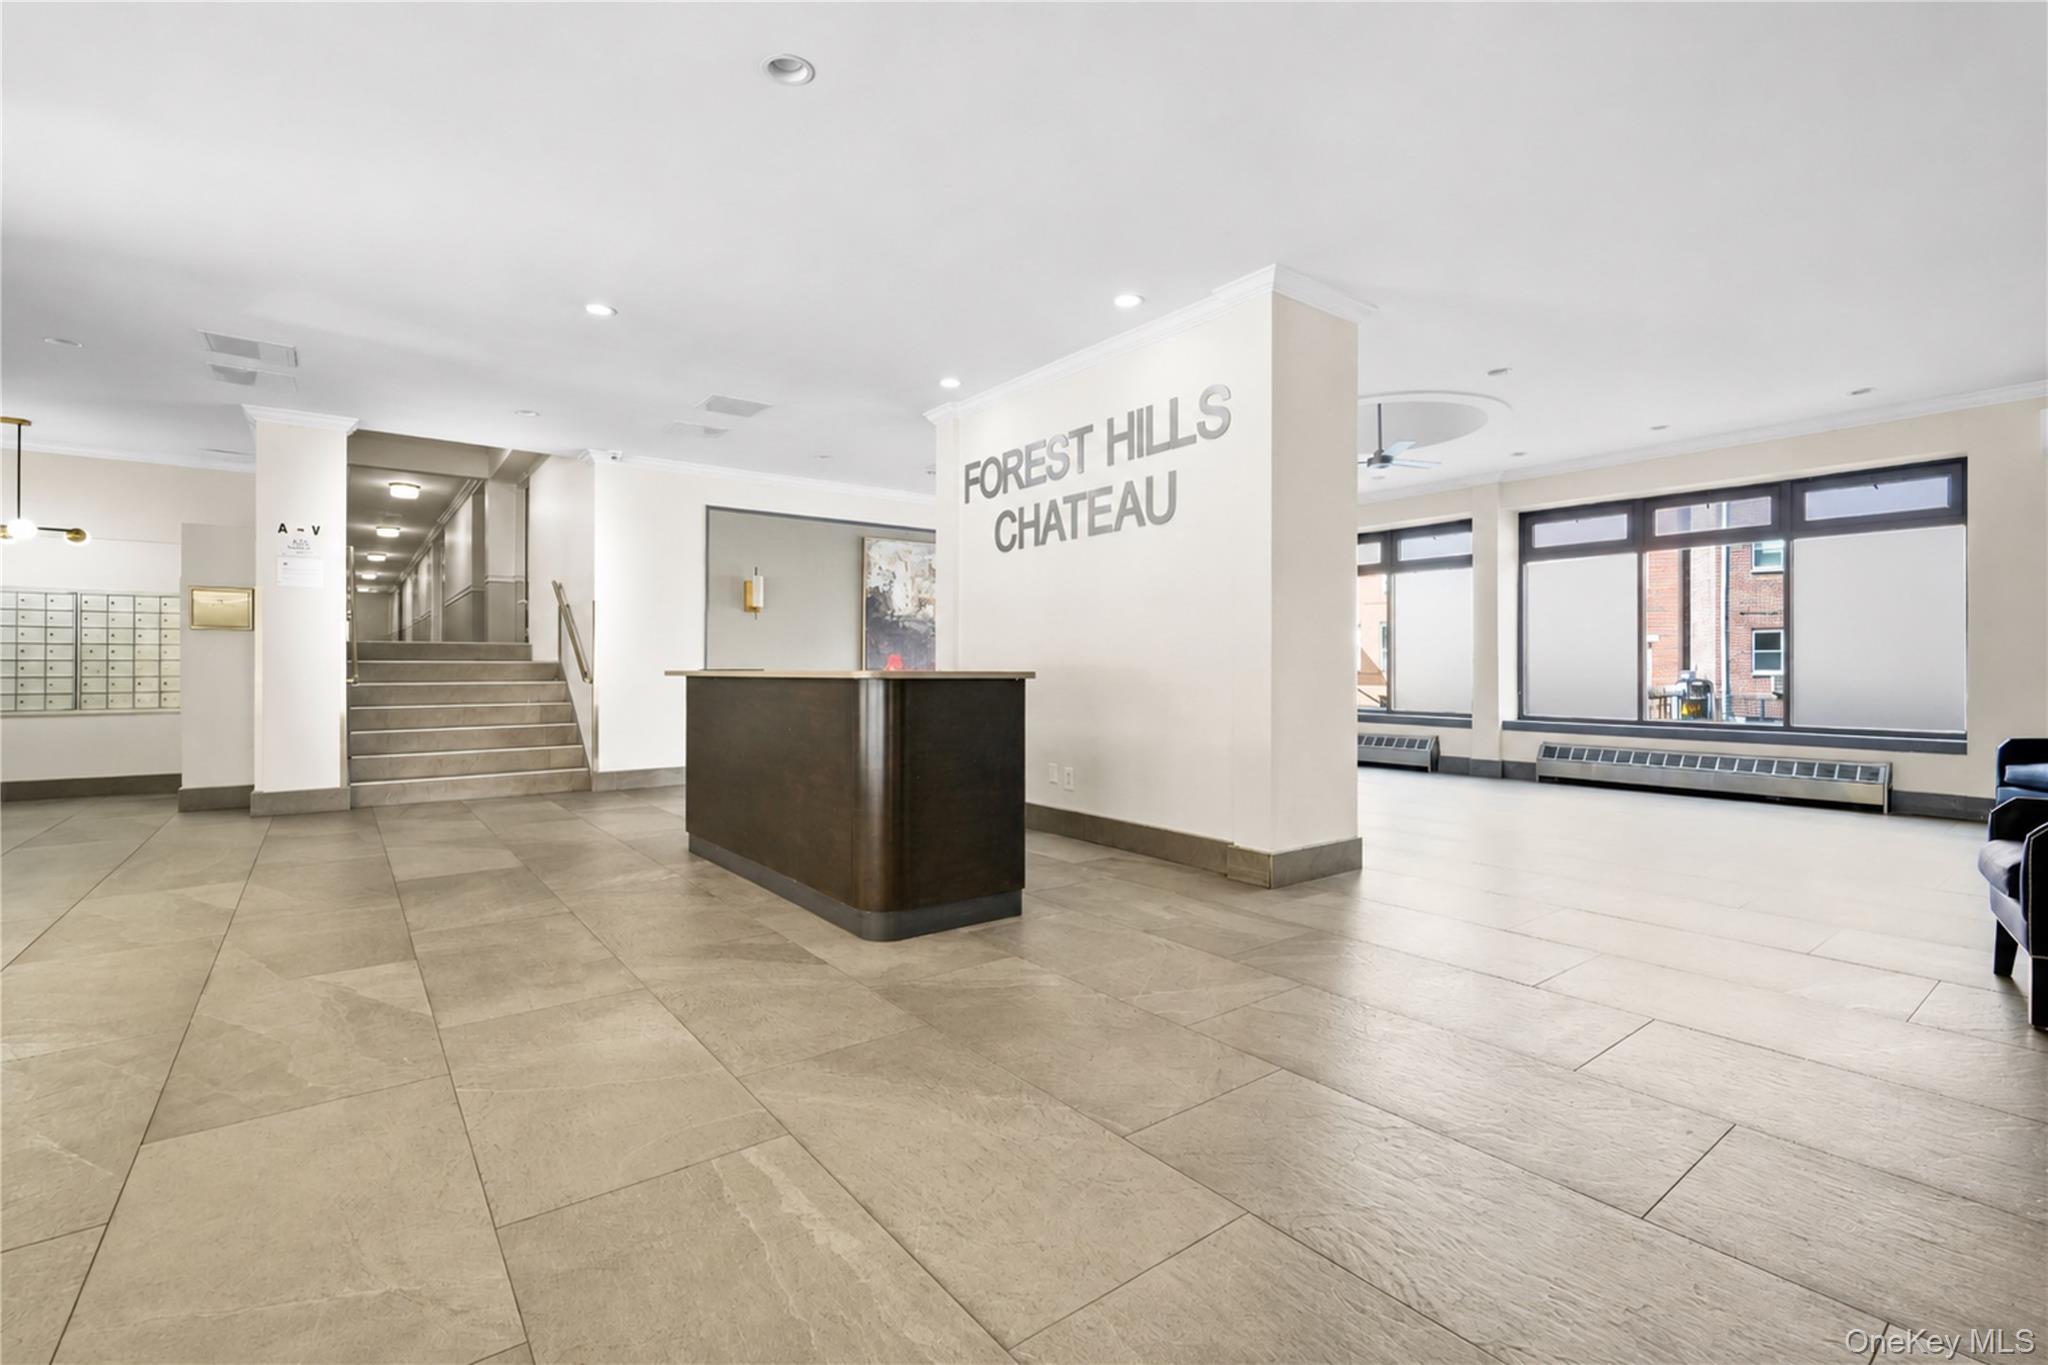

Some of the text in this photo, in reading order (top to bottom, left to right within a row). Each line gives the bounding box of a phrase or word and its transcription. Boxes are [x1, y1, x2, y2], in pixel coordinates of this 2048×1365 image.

[964, 384, 1232, 504] FOREST HILLS
[278, 523, 288, 534] A
[311, 525, 321, 536] V
[994, 470, 1178, 553] CHATEAU
